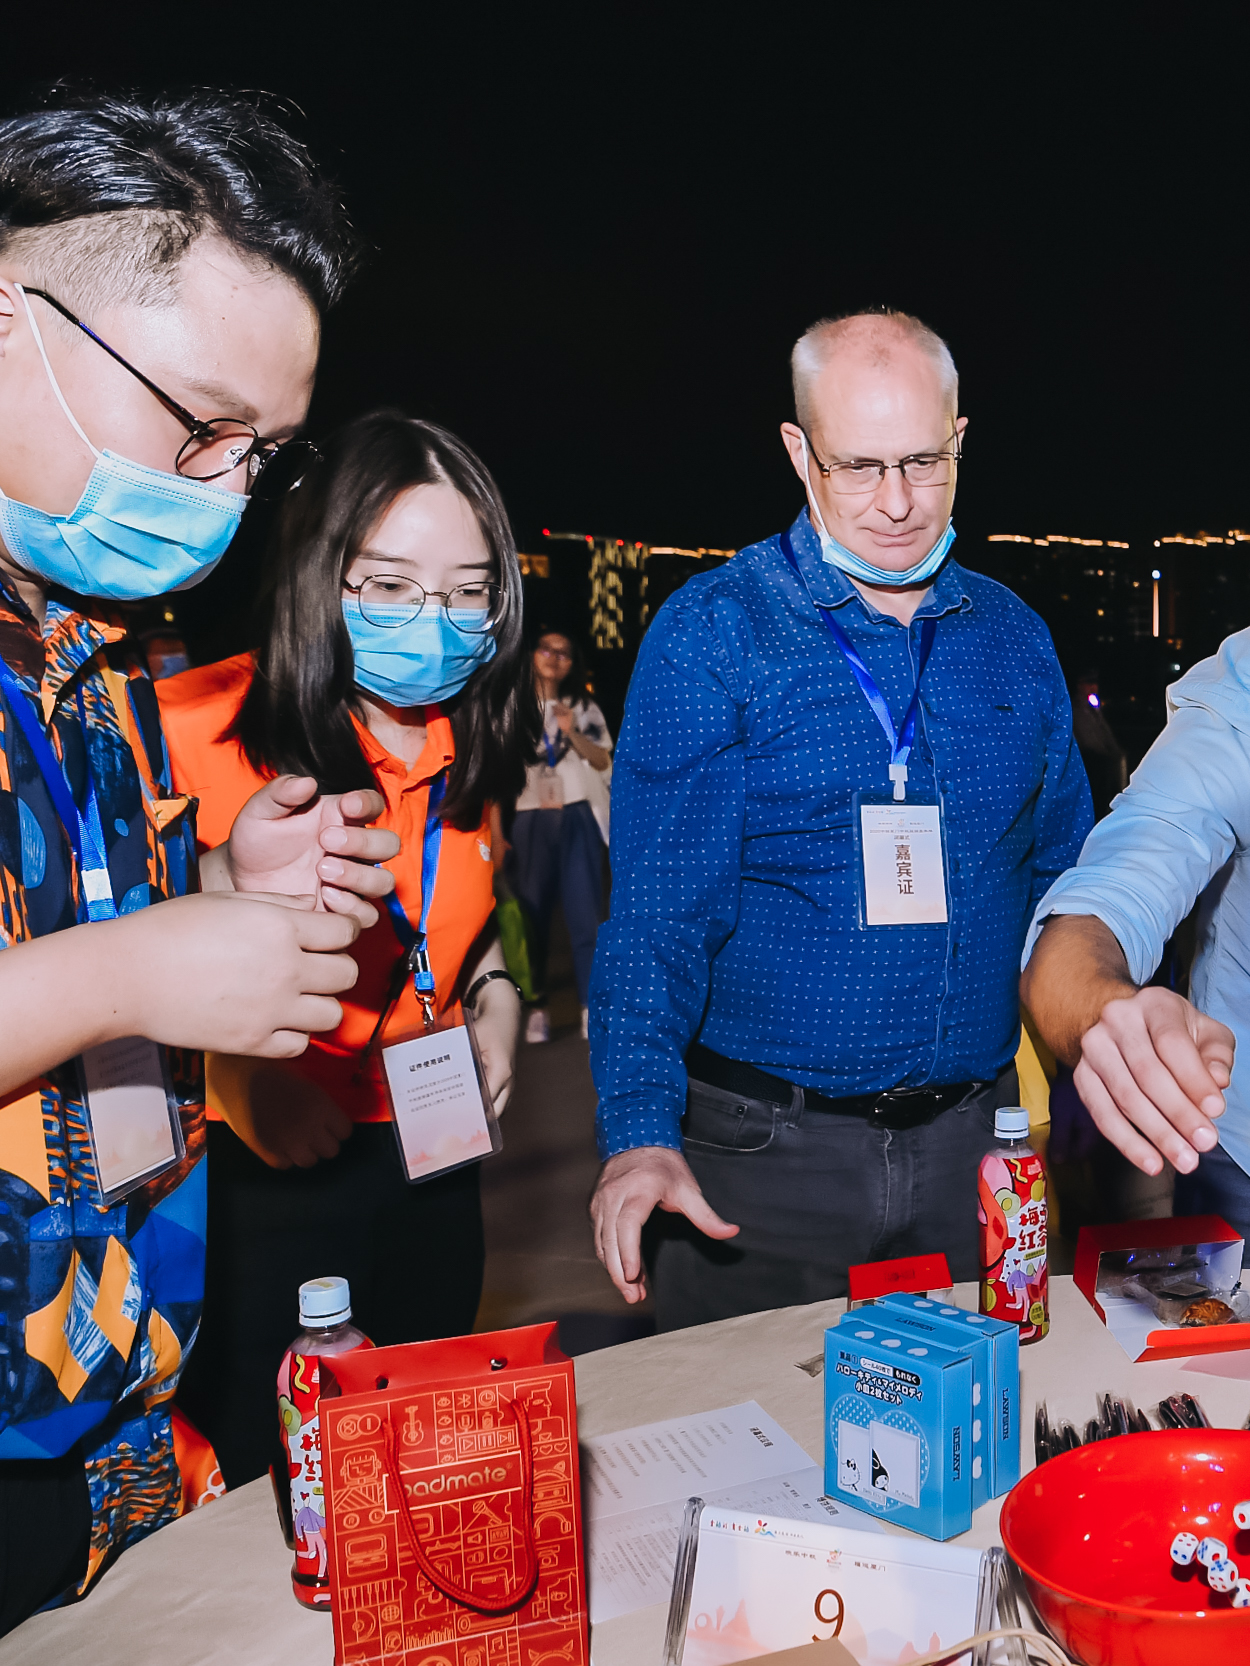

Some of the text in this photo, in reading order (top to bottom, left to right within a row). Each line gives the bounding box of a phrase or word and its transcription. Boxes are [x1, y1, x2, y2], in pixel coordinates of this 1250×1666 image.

[894, 844, 915, 895] 嘉宾证
[408, 1054, 451, 1072] 证件使用说明
[895, 1317, 936, 1332] LAWSON
[895, 1370, 917, 1384] もれなく
[952, 1426, 961, 1482] LAWSON
[812, 1589, 844, 1642] 9
